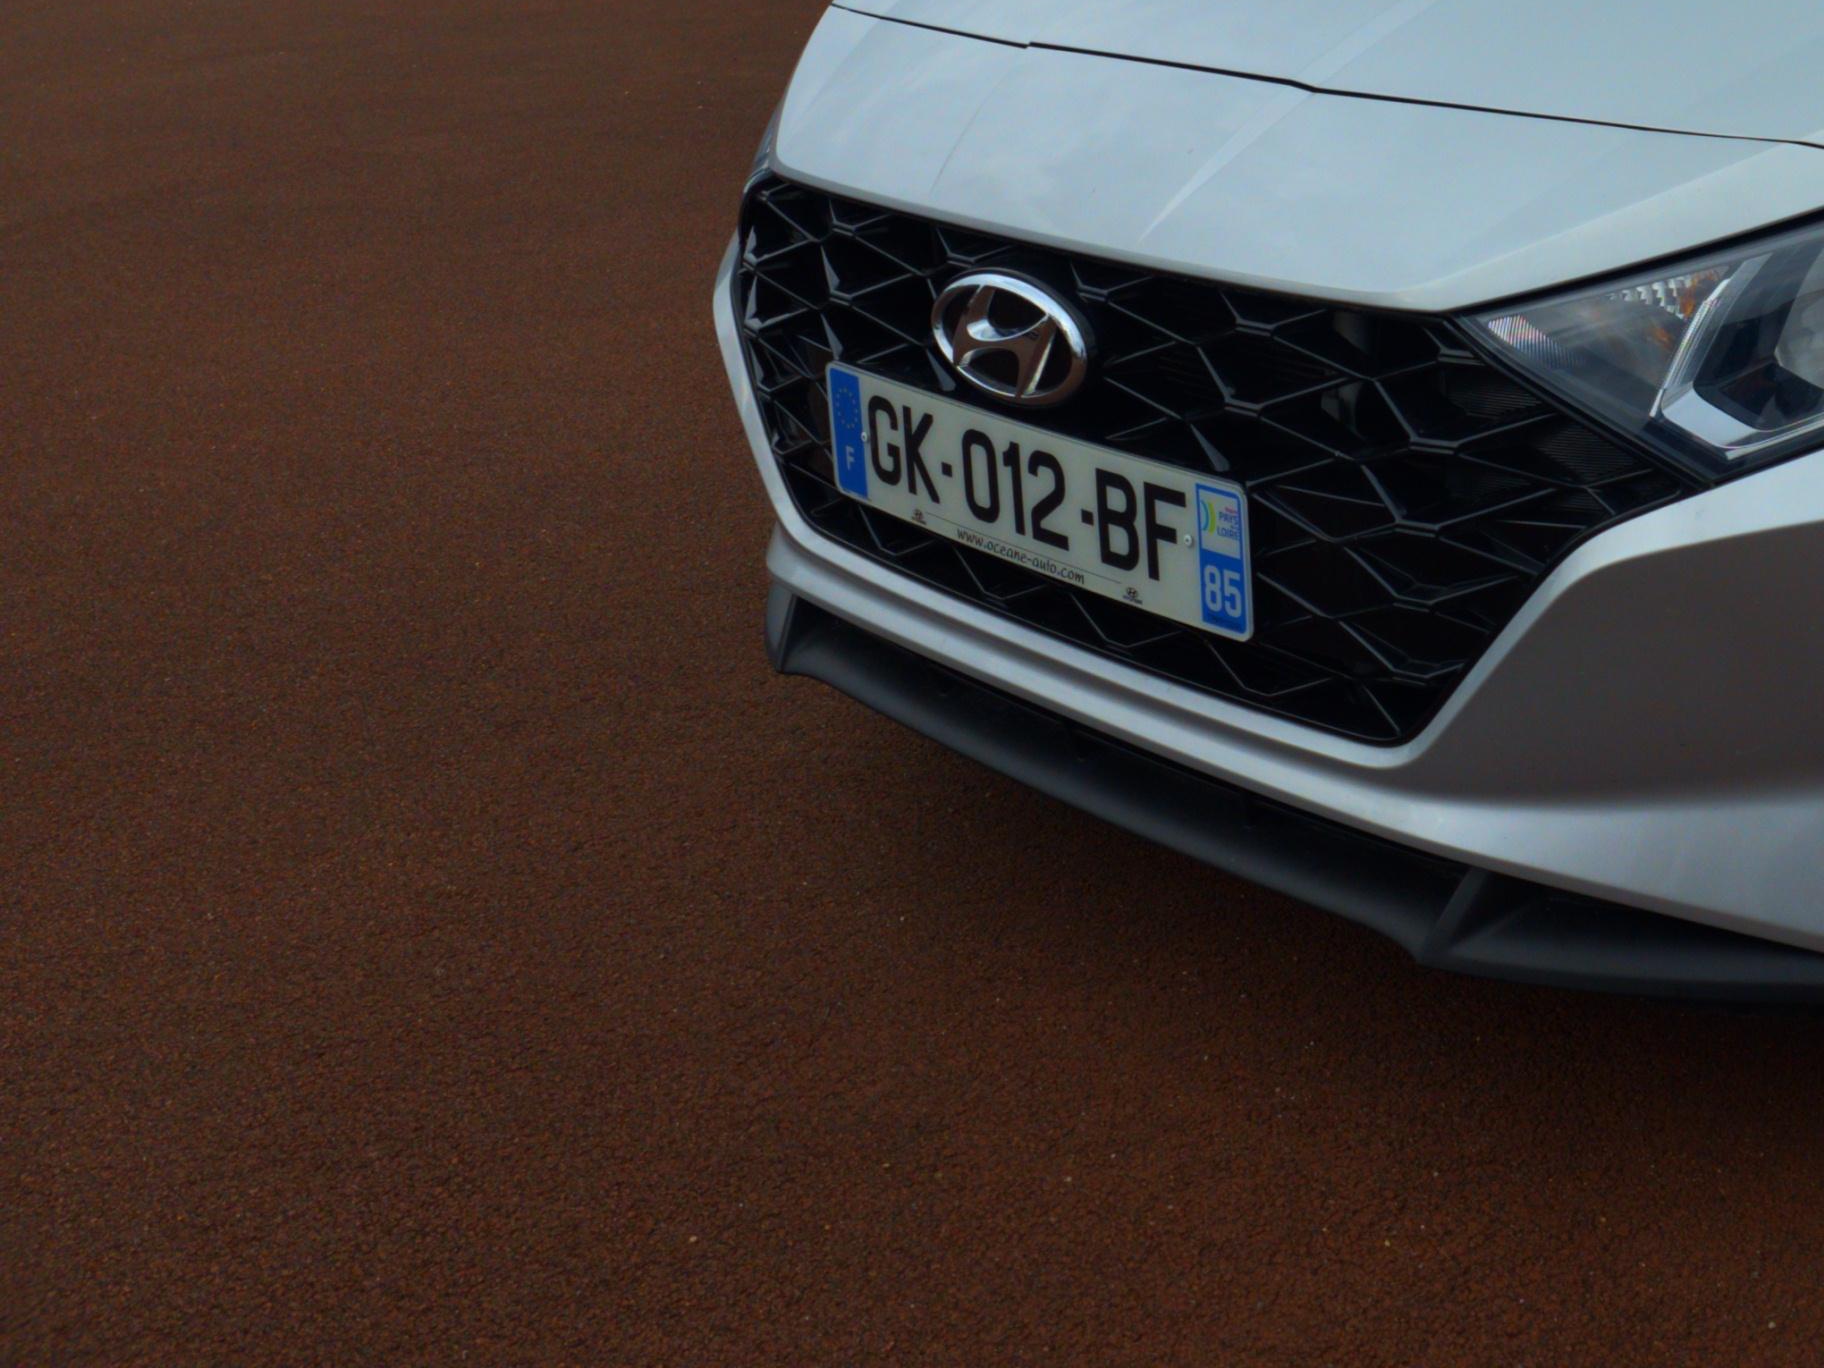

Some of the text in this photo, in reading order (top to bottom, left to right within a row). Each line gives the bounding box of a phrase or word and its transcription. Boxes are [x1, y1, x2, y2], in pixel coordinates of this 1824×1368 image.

[845, 444, 855, 471] F
[867, 395, 1186, 581] GK-012-BF
[956, 528, 1086, 585] www.oceane-auto.com
[1203, 564, 1243, 618] 85
